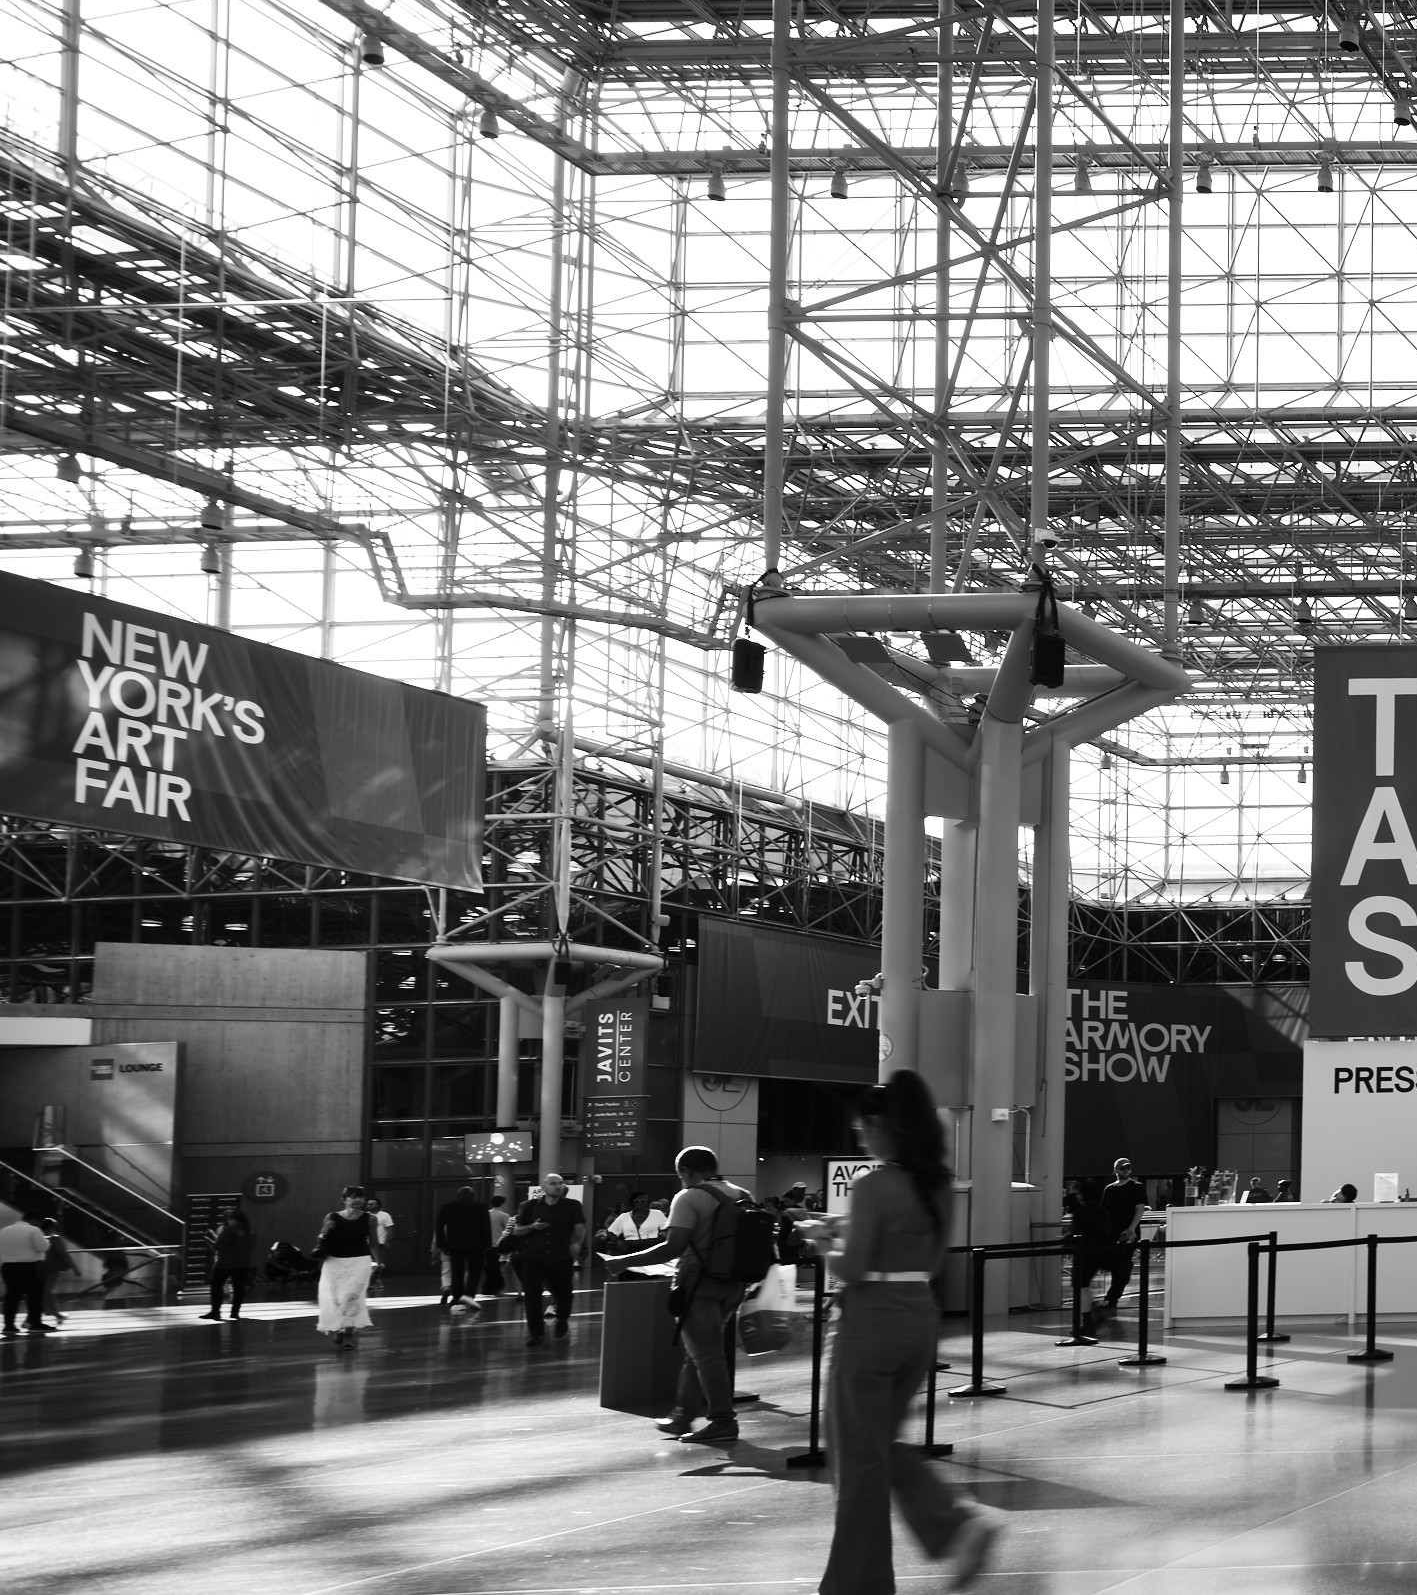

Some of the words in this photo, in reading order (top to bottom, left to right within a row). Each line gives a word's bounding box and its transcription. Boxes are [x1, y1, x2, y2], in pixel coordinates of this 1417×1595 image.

[82, 612, 209, 684] NEW
[76, 659, 265, 744] YORK’S
[72, 711, 188, 772] ART
[75, 757, 191, 822] FAIR
[1066, 988, 1128, 1020] THE
[119, 1063, 163, 1073] LOUNGE
[596, 1012, 614, 1083] JAVITS
[618, 1011, 633, 1083] CENTER
[1065, 1020, 1212, 1053] ARMORY
[1065, 1052, 1171, 1083] SHOW
